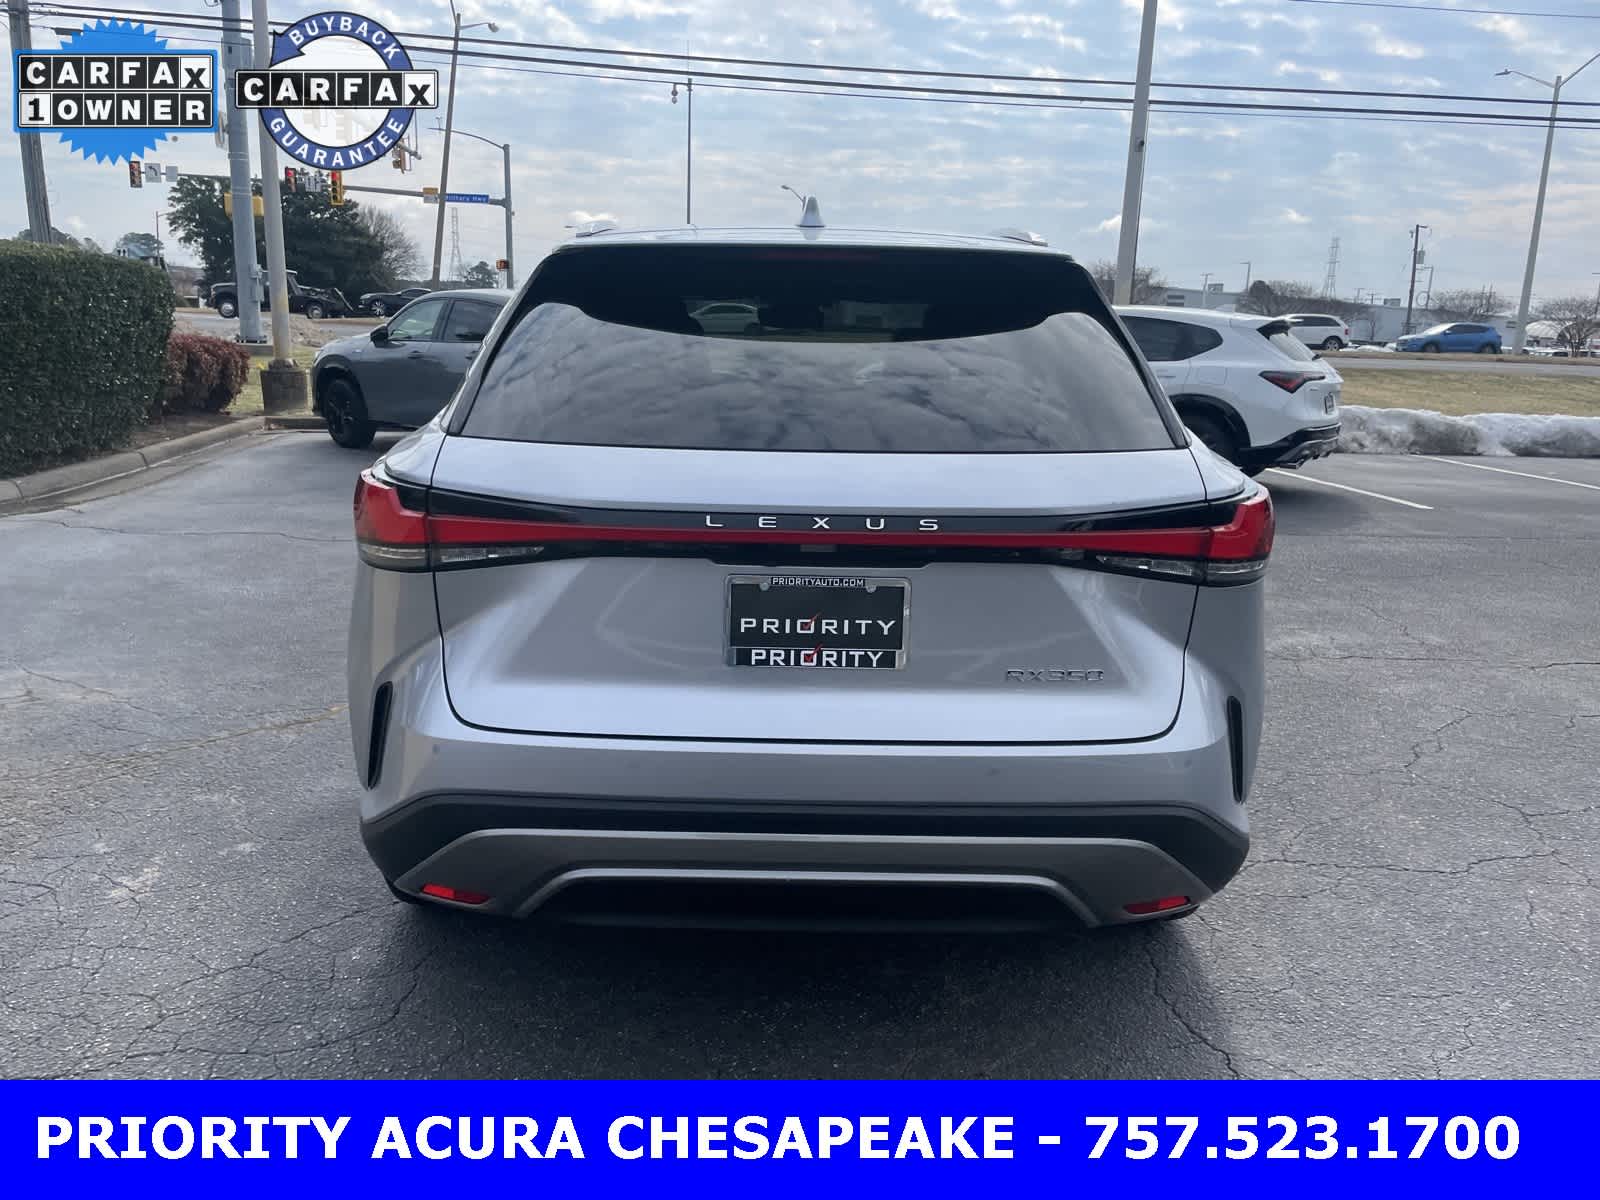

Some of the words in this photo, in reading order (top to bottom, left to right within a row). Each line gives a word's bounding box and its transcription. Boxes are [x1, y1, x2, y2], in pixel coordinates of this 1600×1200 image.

[705, 515, 939, 531] LEXUS
[772, 577, 865, 588] PRIORITYAUTO.COM
[740, 616, 896, 636] PRIORITY
[751, 649, 884, 668] PRIORITY
